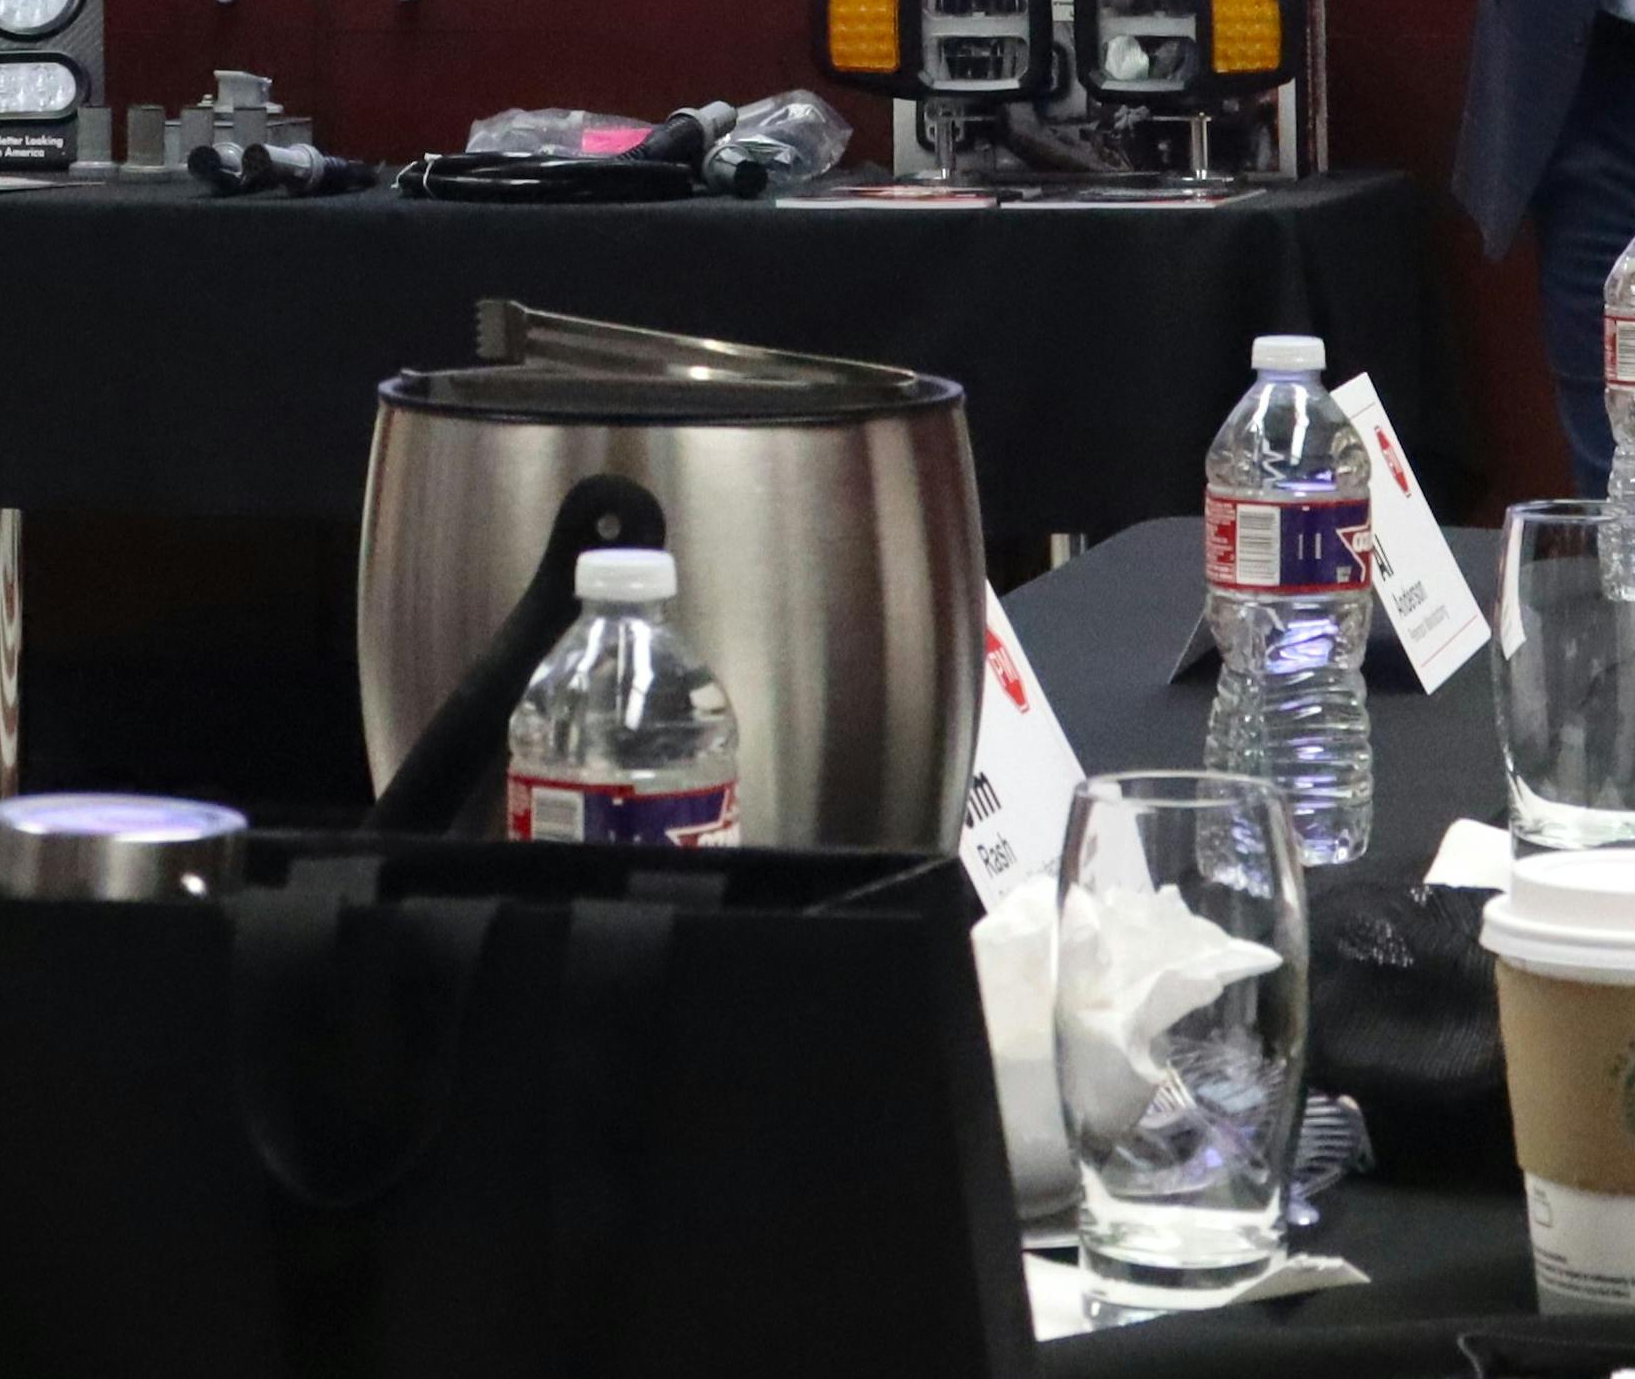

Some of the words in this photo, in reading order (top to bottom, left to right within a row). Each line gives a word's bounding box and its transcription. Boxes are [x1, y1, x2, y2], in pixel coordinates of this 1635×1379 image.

[25, 134, 64, 149] Looking
[4, 147, 46, 158] America
[976, 831, 1018, 880] Rash
